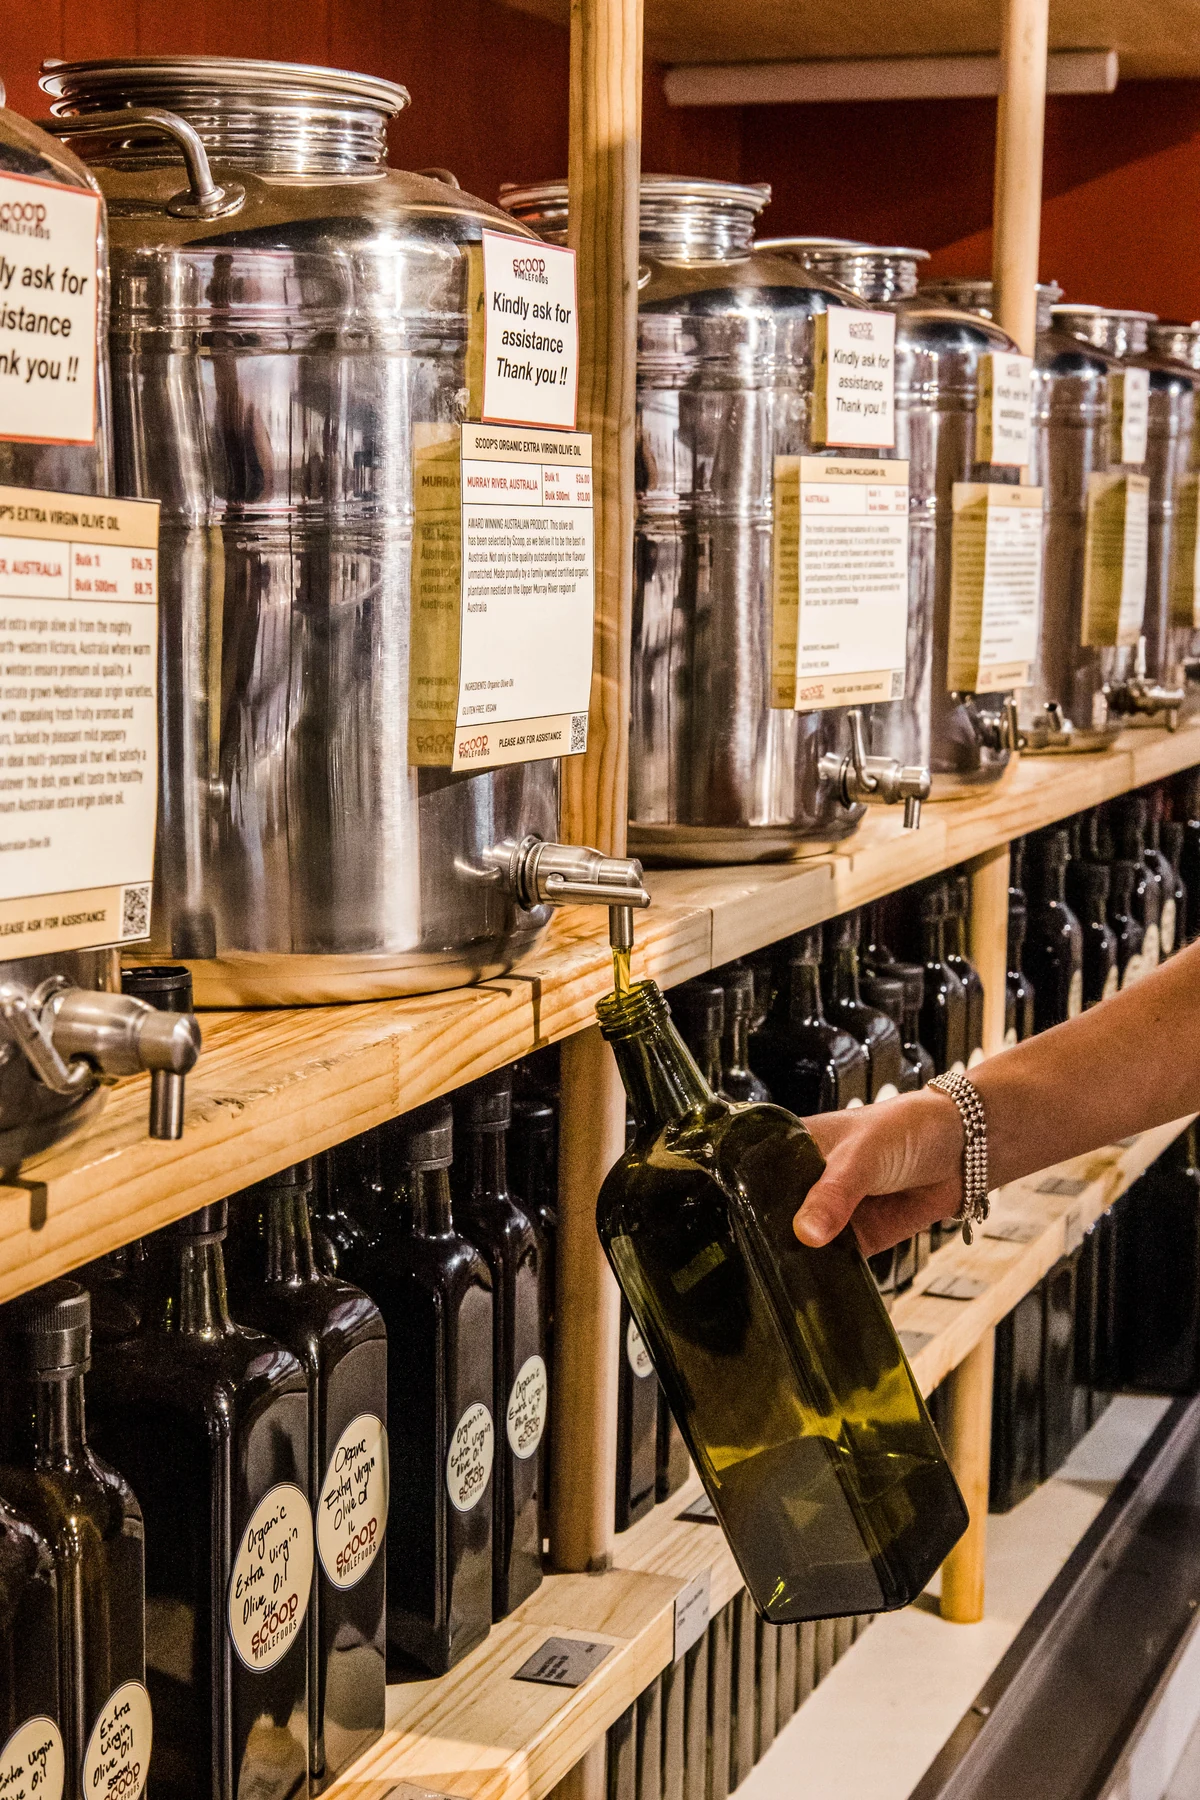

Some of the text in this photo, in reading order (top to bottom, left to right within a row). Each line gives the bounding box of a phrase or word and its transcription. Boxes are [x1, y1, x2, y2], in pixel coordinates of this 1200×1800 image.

[22, 264, 55, 291] ask
[61, 267, 88, 295] for
[514, 270, 549, 286] WHOLEFOODS
[493, 291, 572, 325] Kindly ask for
[0, 302, 72, 338] istance
[502, 329, 564, 354] assistance
[833, 348, 890, 369] Kindly ask for
[27, 357, 61, 384] you
[497, 357, 569, 387] Thank you !!
[838, 375, 884, 392] assistance
[836, 397, 861, 413] Thank
[864, 402, 879, 417] you
[475, 437, 582, 456] SCOOP'S ORGANIC EXTRA VIRGIN OLIVE OIL
[467, 476, 539, 491] MURRAY RIVER, AUSTRALIA
[544, 471, 555, 482] Bulk
[545, 490, 555, 501] Bulk
[17, 506, 46, 523] EXTRA
[49, 510, 79, 526] VIRGIN
[81, 513, 105, 530] OLIVE
[107, 515, 121, 531] OIL
[484, 518, 503, 530] WINNING
[504, 518, 529, 530] AUSTRALIAN
[488, 535, 506, 546] selected
[11, 559, 62, 577] AUSTRALIA
[75, 552, 92, 566] Bulk
[75, 577, 92, 592] Bulk
[467, 602, 487, 613] Australia
[487, 679, 500, 691] Organic
[462, 703, 497, 717] GLUTEN VEGAN
[498, 731, 562, 749] PLEASE ASK FOR ASSISTANCE
[459, 748, 490, 759] WHOLEFOODS
[26, 918, 42, 932] ASK
[44, 916, 60, 930] FOR
[60, 909, 107, 927] ASSISTANCE
[456, 1407, 485, 1444] Organic
[450, 1445, 471, 1468] Extra
[324, 1474, 352, 1511] Extra
[334, 1499, 357, 1531] Olive
[247, 1505, 288, 1561] Organic
[339, 1541, 377, 1579] WHOLEFOODS
[235, 1563, 265, 1599] Extra
[242, 1562, 288, 1625] Olive Oil
[254, 1618, 298, 1662] WHOLEFOODS
[100, 1702, 131, 1740] Extra
[93, 1728, 134, 1788] Olive Oil
